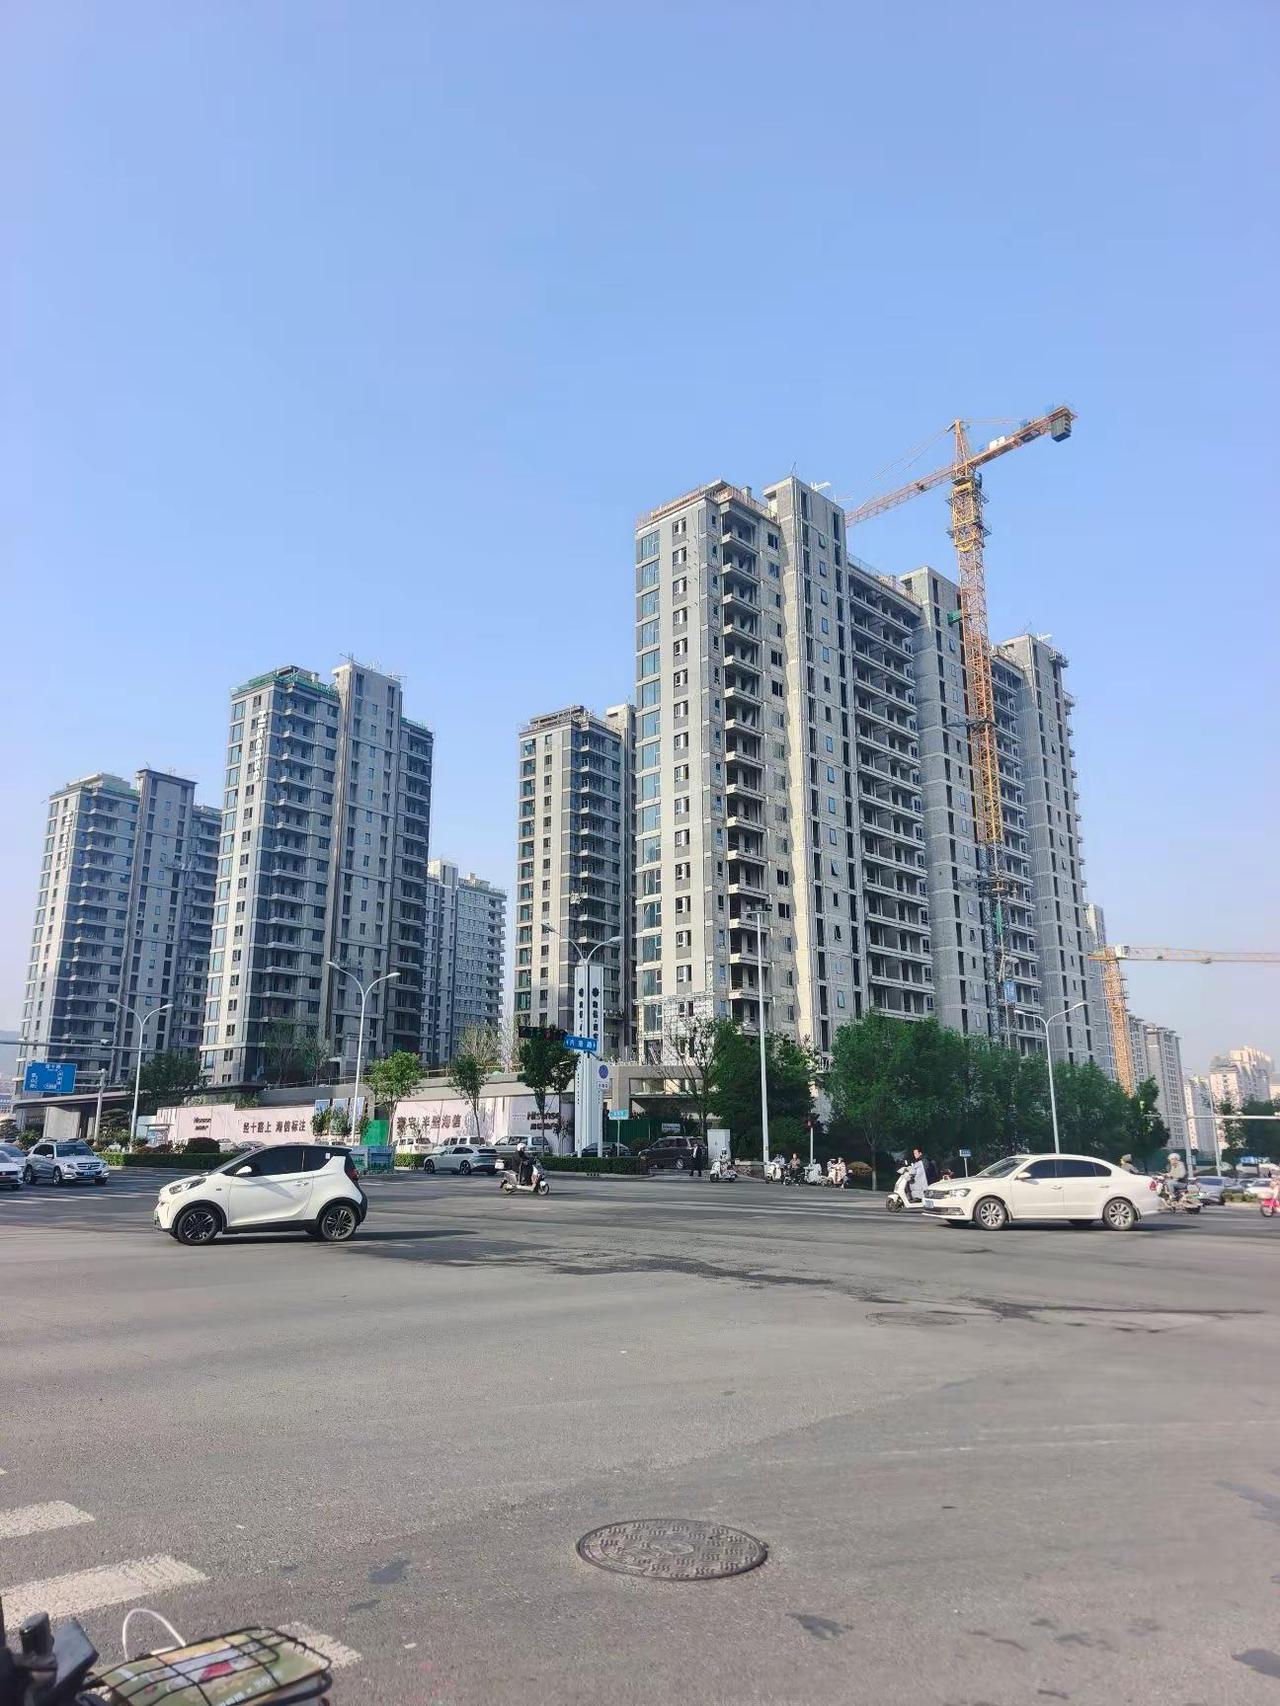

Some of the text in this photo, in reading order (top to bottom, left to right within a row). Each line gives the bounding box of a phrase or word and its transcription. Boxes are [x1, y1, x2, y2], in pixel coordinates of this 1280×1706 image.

[527, 1111, 560, 1121] Hisnse
[243, 1122, 271, 1133] 经十路上
